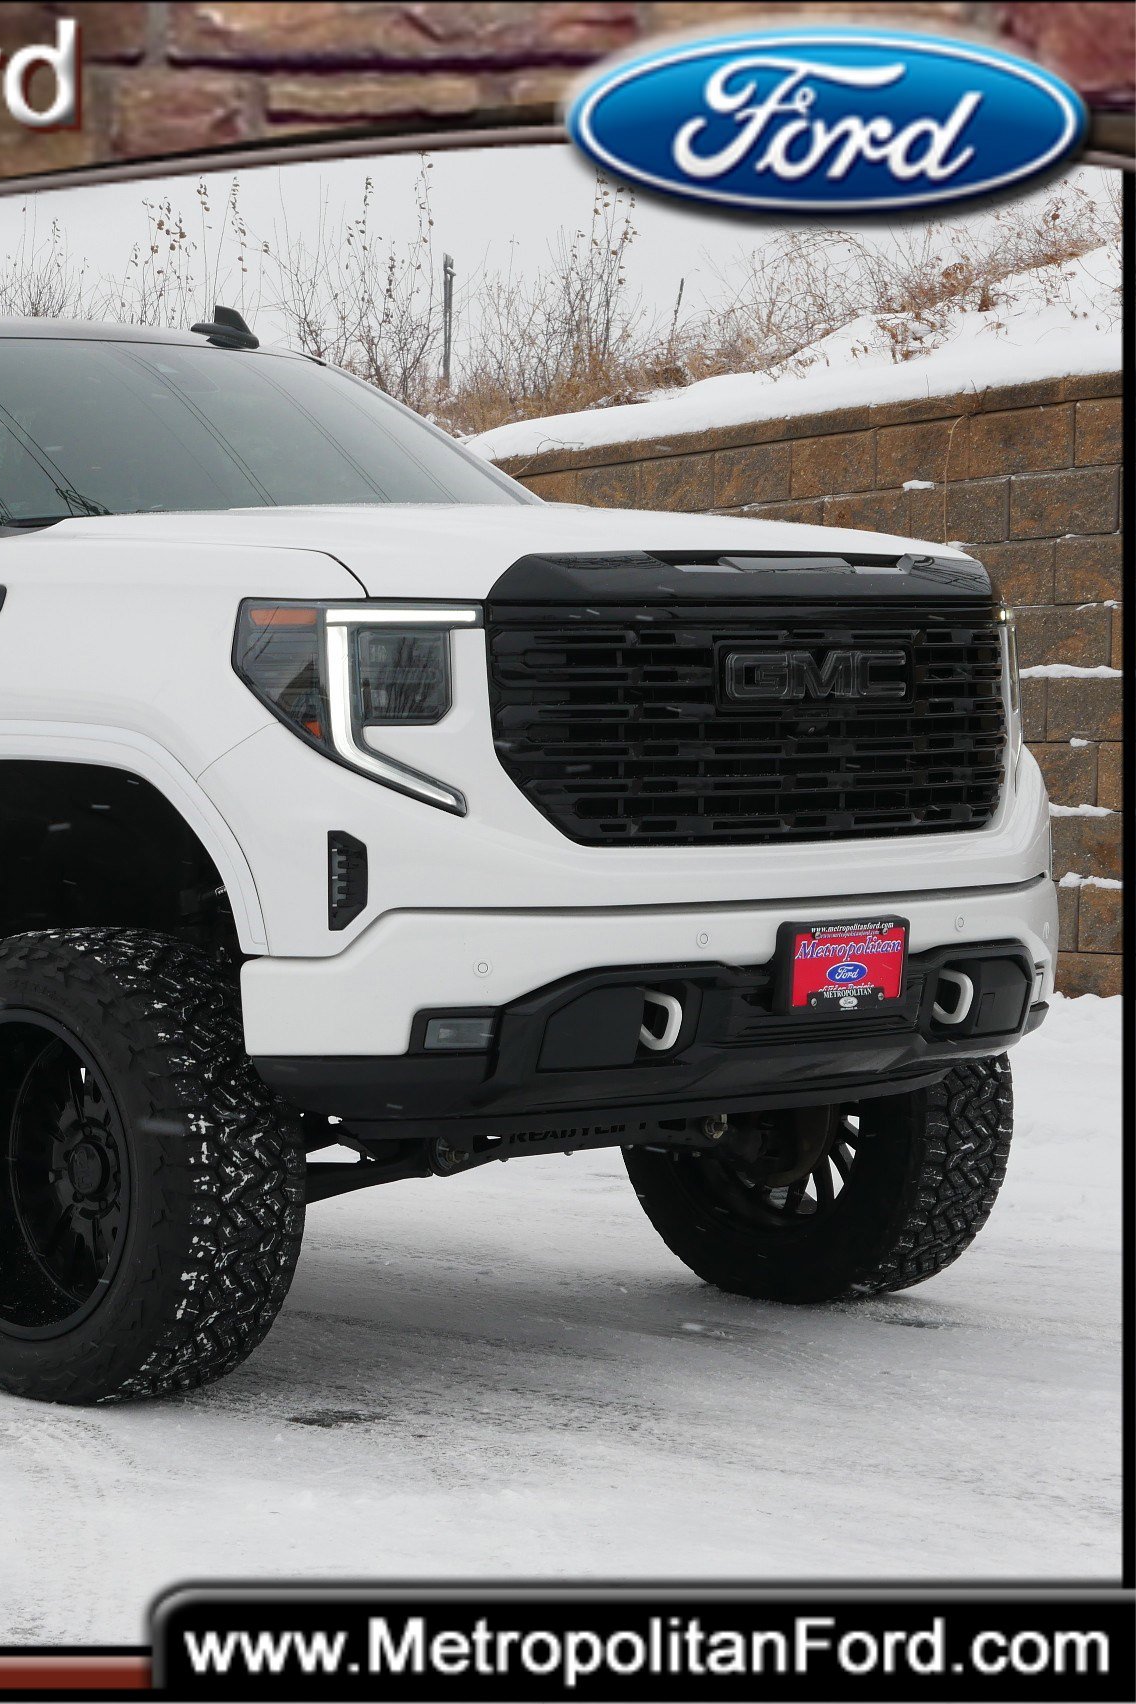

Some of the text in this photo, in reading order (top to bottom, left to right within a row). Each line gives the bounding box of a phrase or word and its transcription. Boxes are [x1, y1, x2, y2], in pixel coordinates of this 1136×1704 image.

[725, 650, 907, 700] GMC
[811, 921, 894, 934] www.metropolitanford.com
[794, 935, 902, 961] Metropolitan
[835, 966, 860, 979] Ford
[823, 988, 872, 999] METROPOLITAN
